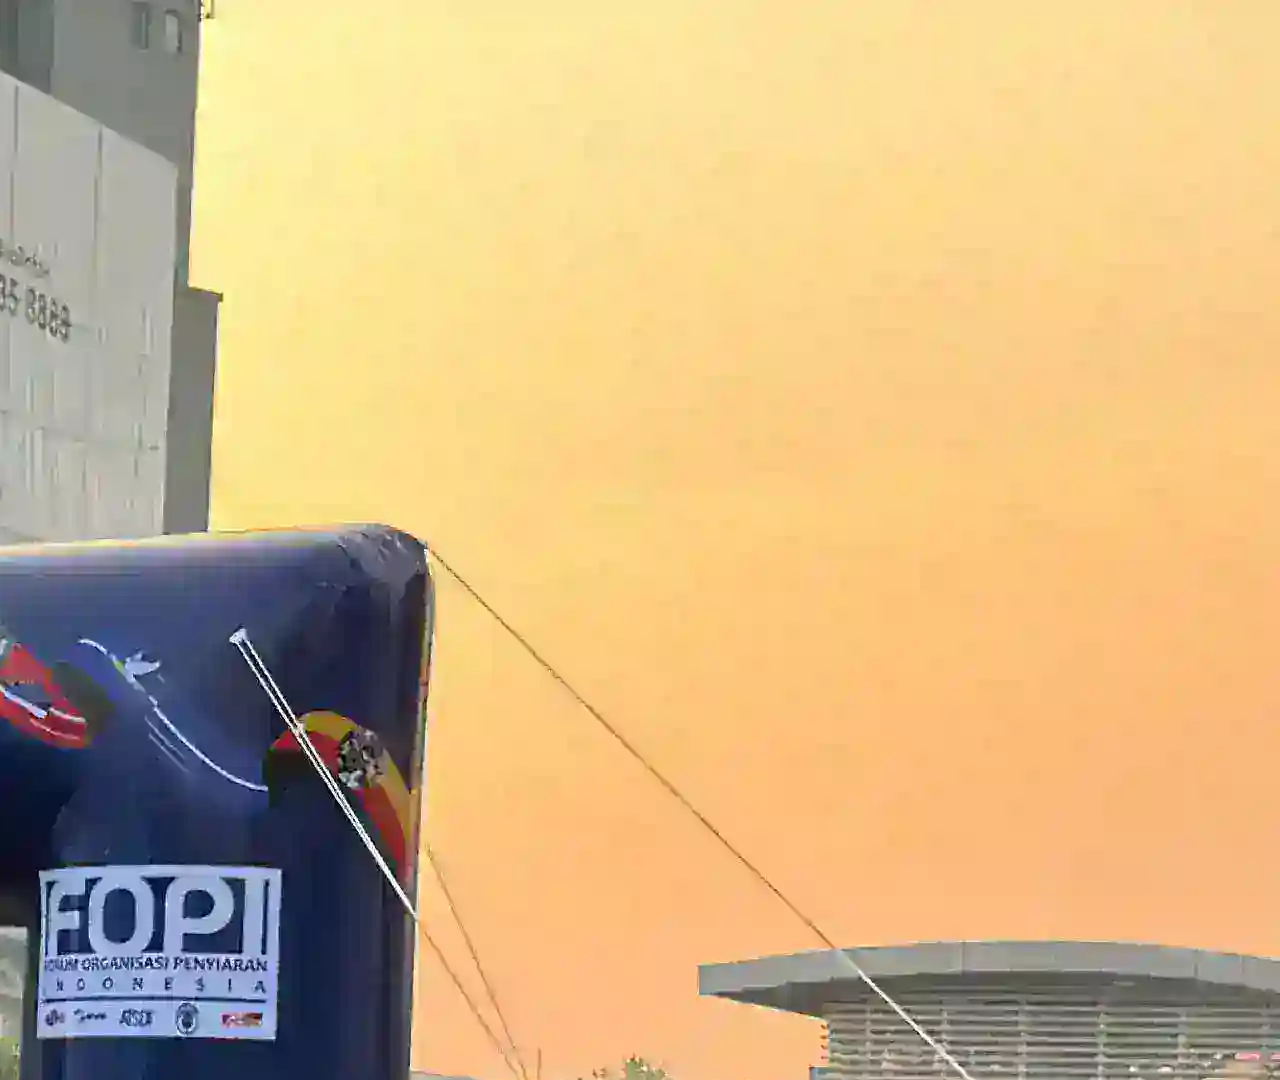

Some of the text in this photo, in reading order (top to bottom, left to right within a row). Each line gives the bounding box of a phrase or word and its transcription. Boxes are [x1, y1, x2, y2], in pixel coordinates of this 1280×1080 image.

[47, 876, 264, 955] FOPI
[174, 956, 269, 972] PENYIARAN
[56, 976, 267, 993] NDONESIA
